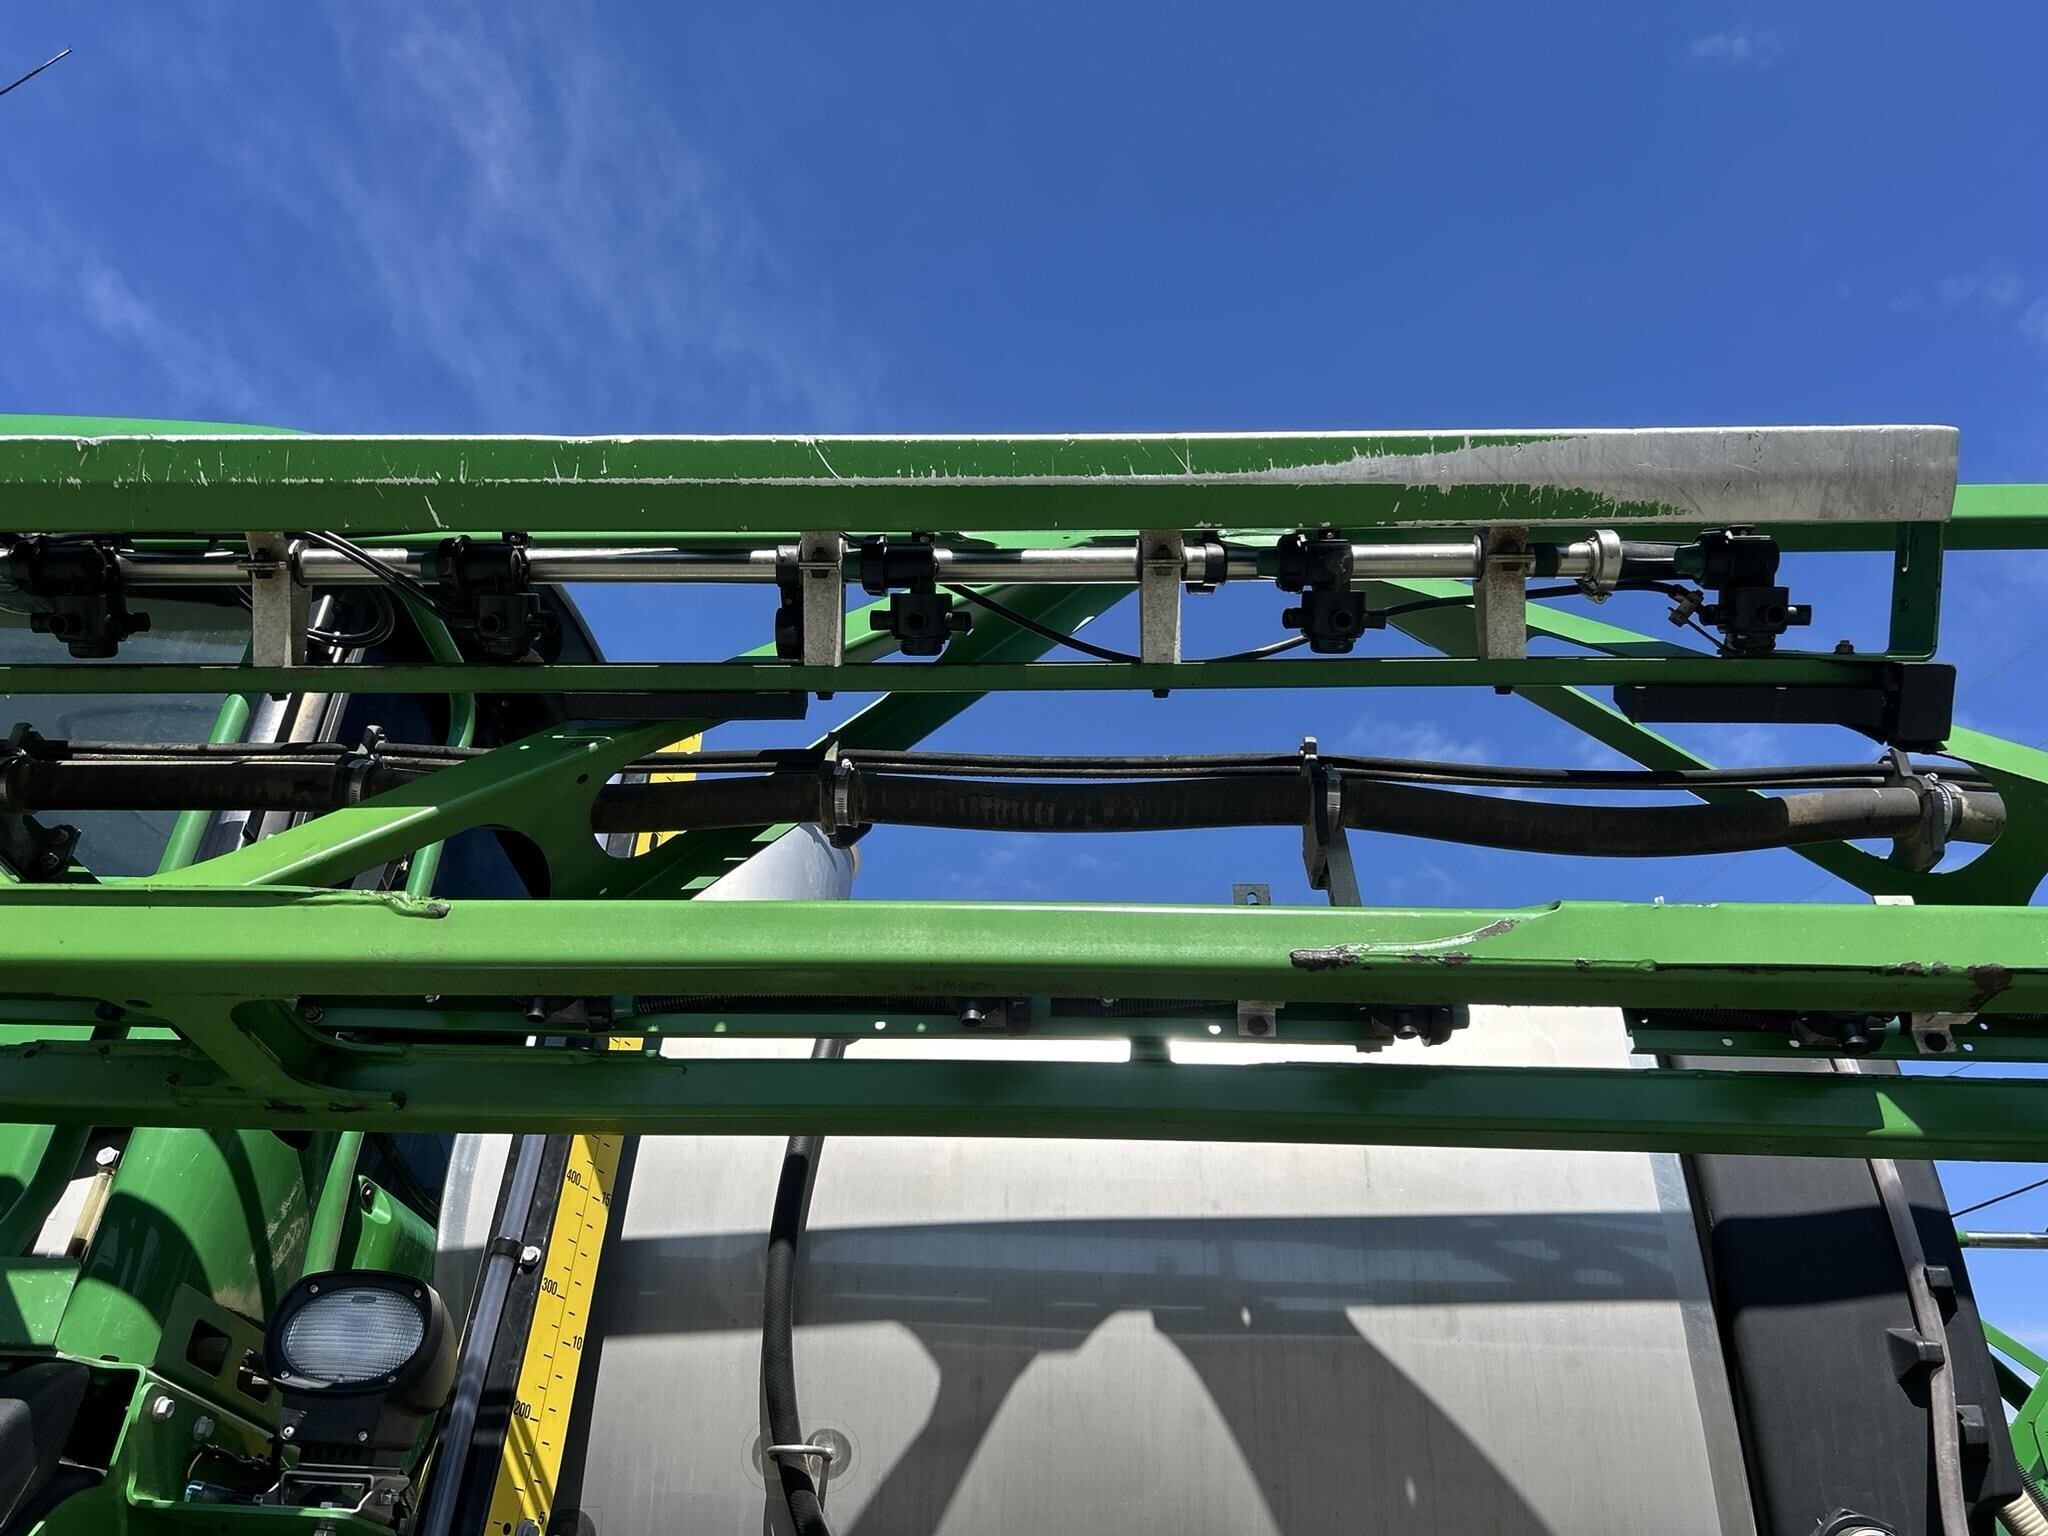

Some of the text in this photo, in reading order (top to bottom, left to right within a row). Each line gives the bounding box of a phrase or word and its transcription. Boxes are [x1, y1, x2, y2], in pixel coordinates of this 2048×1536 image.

[566, 1168, 582, 1186] 400
[601, 1191, 611, 1207] 15
[541, 1277, 557, 1295] 300
[572, 1335, 583, 1350] 10
[513, 1400, 531, 1419] 200
[538, 1511, 545, 1525] 5
